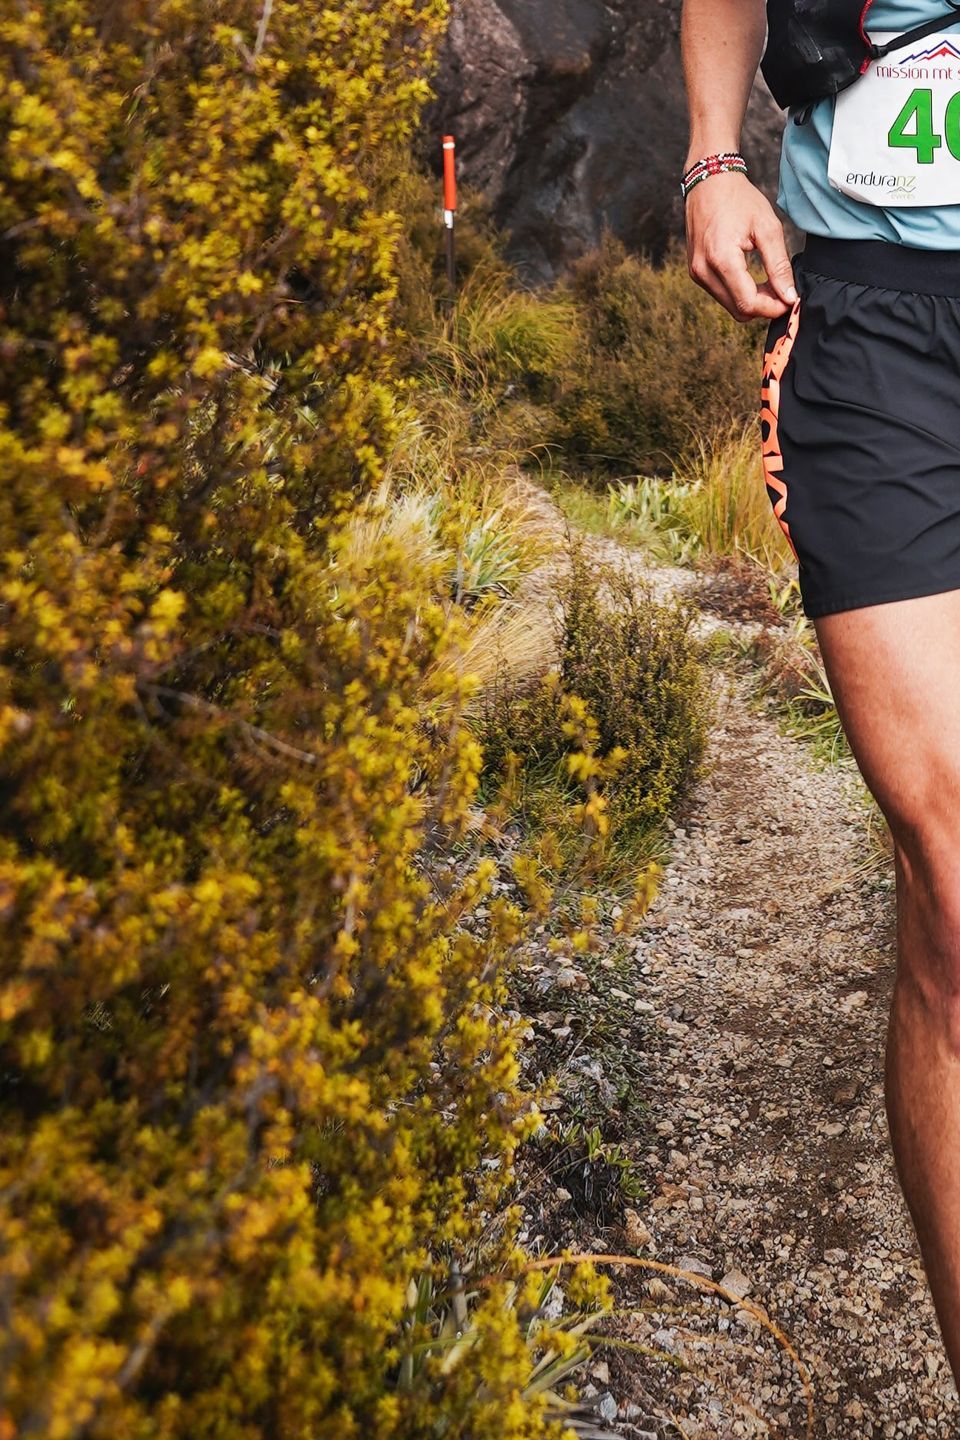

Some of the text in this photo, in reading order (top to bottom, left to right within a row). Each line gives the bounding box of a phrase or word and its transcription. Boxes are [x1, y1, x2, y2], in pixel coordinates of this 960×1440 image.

[876, 64, 928, 80] mission
[932, 65, 954, 80] mt
[846, 171, 917, 188] enduranz
